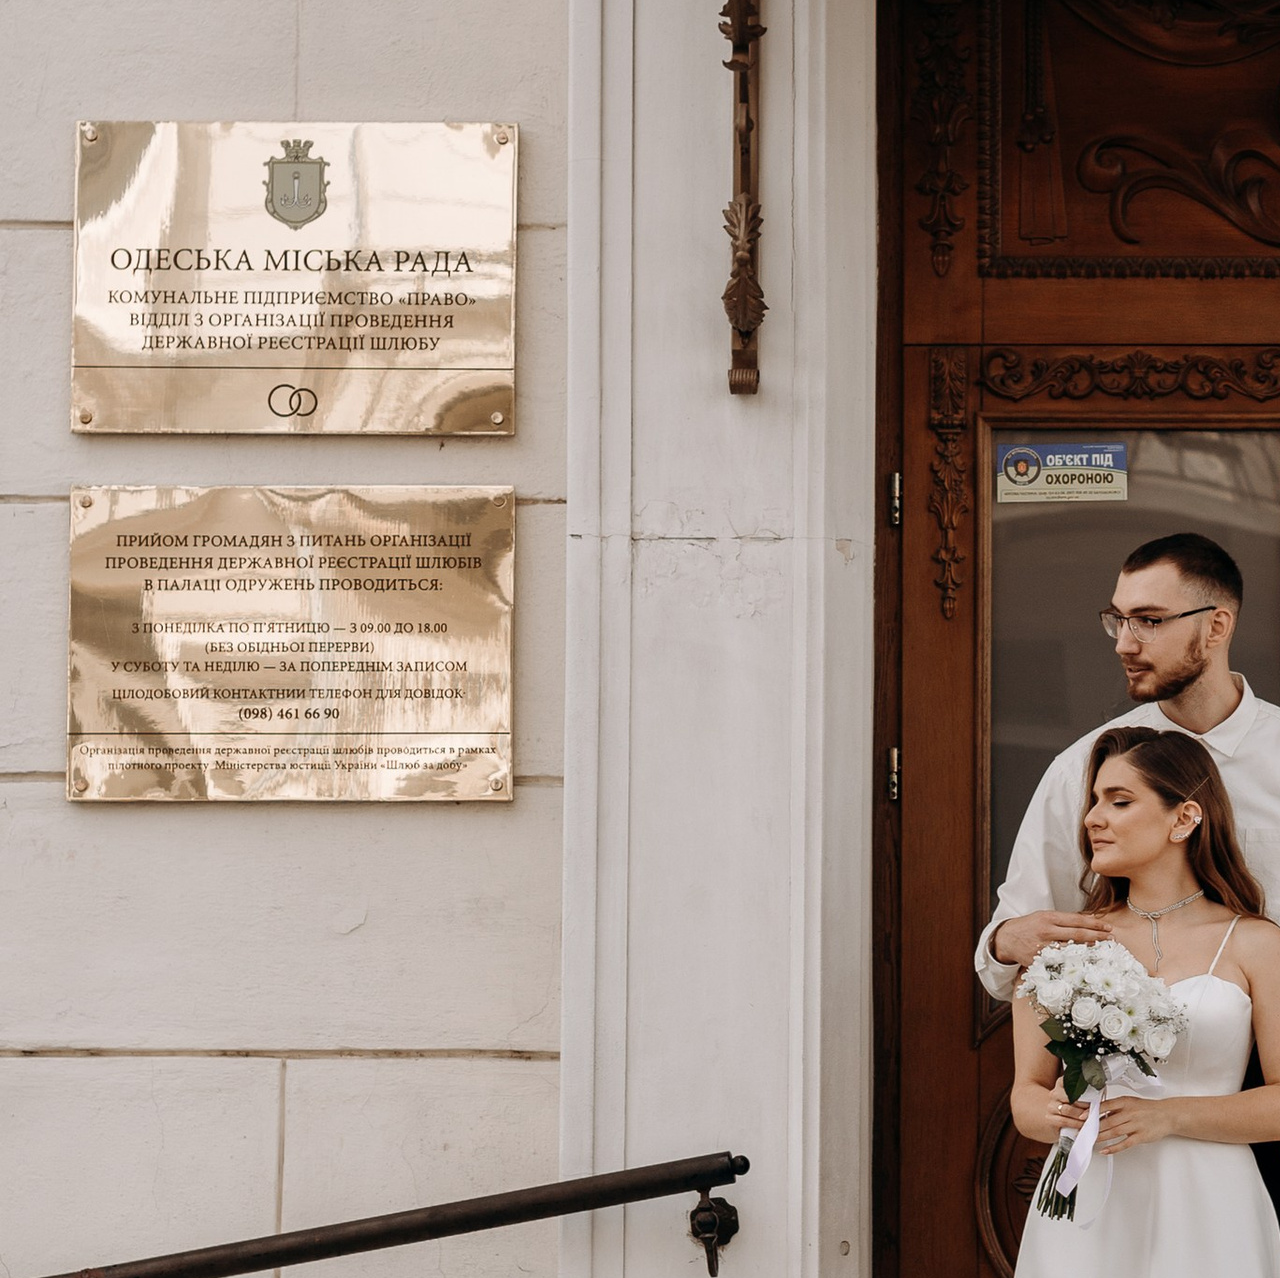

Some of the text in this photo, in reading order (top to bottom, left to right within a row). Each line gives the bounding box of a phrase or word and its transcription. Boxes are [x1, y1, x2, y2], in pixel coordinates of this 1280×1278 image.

[110, 248, 474, 277] ОДЕСЬКА МІСЬКА РАДА
[108, 289, 476, 307] КОМУНАЛЬНЕ ПІДПРИЄМСТВО «ПРАВО»
[129, 312, 190, 328] ВІДДІЛ
[208, 311, 325, 330] ОРГАНІЗАЦІЇ
[330, 313, 454, 330] ПРОВЕДЕННЯ
[141, 333, 441, 352] ДЕРЖАВНОЇ РЕЄСТРАЦІЇ ШЛЮБУ
[1091, 453, 1114, 467] ПІД
[1045, 473, 1114, 485] ОХОРОНОЮ
[116, 533, 190, 547] ПРИЙОМ
[193, 534, 283, 549] ГРОМАДЯН
[300, 534, 366, 547] ПИТАНЬ
[370, 533, 472, 549] ОРГАНІЗАЦІЇ
[105, 555, 482, 571] ПРОВЕДЕННЯ ДЕРЖАВНОЇ РЕЄСТРАЦІЇ ШЛЮБІВ
[144, 579, 443, 593] В ПАЛАЦІ ОДРУЖЕНЬ ПРОВОДИТЬСЯ:
[143, 622, 225, 635] ПОНЕДІЛКА
[229, 622, 250, 633] ПО
[360, 623, 391, 633] 09.00
[393, 622, 414, 635] ДО
[418, 623, 447, 633] 18.00
[205, 641, 233, 653] (БЕЗ
[308, 641, 374, 654] ПЕРЕРВИ)
[111, 661, 121, 672] У
[123, 661, 180, 672] СУБОТУ
[183, 661, 200, 672] ТА
[204, 661, 260, 673] НЕДІЛЮ
[279, 661, 295, 672] ЗА
[300, 661, 393, 673] ПОПЕРЕДНІМ
[396, 661, 467, 672] ЗАПИСОМ
[112, 687, 211, 700] ЦІЛОДОБОВИЙ
[309, 688, 372, 699] ТЕЛЕФОН
[375, 688, 400, 700] ДЛЯ
[238, 707, 340, 721] (098) 461 66 90
[79, 745, 145, 756] Організація
[148, 747, 211, 757] проведення
[214, 745, 271, 757] державної
[332, 745, 374, 755] шлюбів
[376, 747, 446, 757] проводиться
[458, 747, 497, 757] рамках
[108, 761, 162, 771] пілотного
[164, 762, 209, 772] проекту
[215, 761, 287, 772] Міністерства
[289, 761, 331, 771] юстиції
[334, 761, 377, 772] України
[380, 760, 420, 770] «Шлюб
[436, 760, 468, 772] добу»
